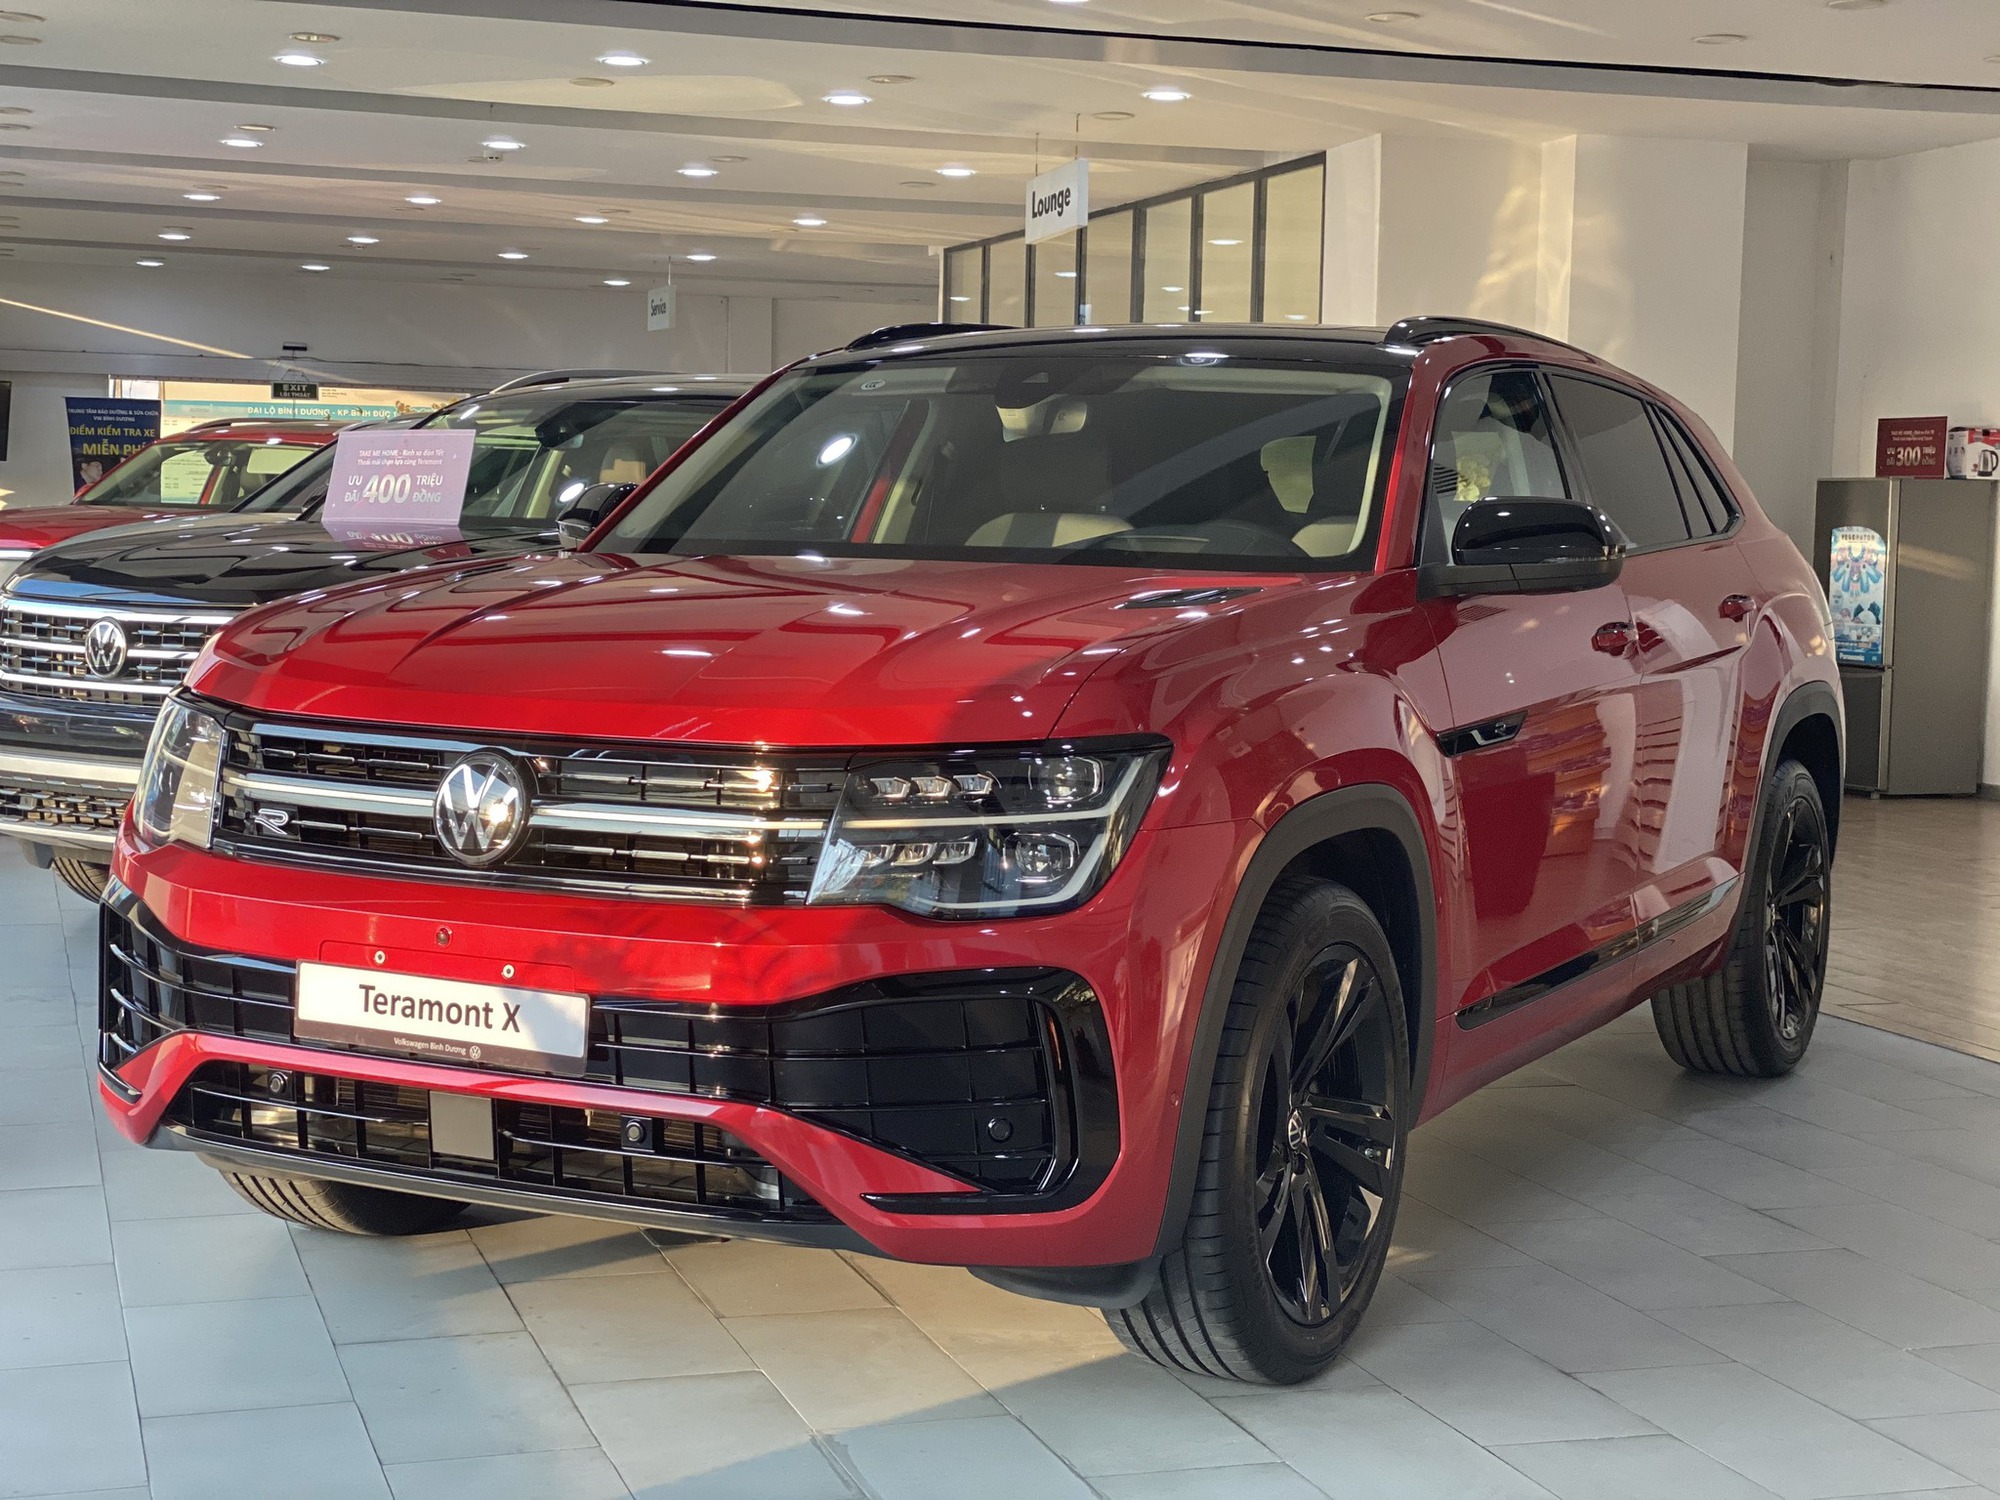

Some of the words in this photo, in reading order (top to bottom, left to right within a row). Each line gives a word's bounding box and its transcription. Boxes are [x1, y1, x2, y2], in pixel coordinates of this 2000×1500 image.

[1031, 187, 1071, 219] Lounge
[650, 297, 667, 317] Service
[282, 383, 308, 392] EXIT
[69, 423, 95, 436] ĐIỂM
[97, 423, 121, 436] KIỂM
[123, 427, 142, 437] TRA
[143, 428, 156, 437] XE
[82, 438, 120, 456] MIỄN
[1895, 445, 1921, 467] 300
[344, 489, 360, 503] ĐÃI
[412, 488, 442, 503] ĐỒNG
[348, 475, 363, 486] ƯU
[362, 473, 412, 504] 400
[416, 472, 444, 488] TRIỆU
[254, 808, 289, 835] R
[358, 983, 494, 1030] Teramont
[501, 1002, 521, 1033] X
[393, 1036, 430, 1050] Volkswagen
